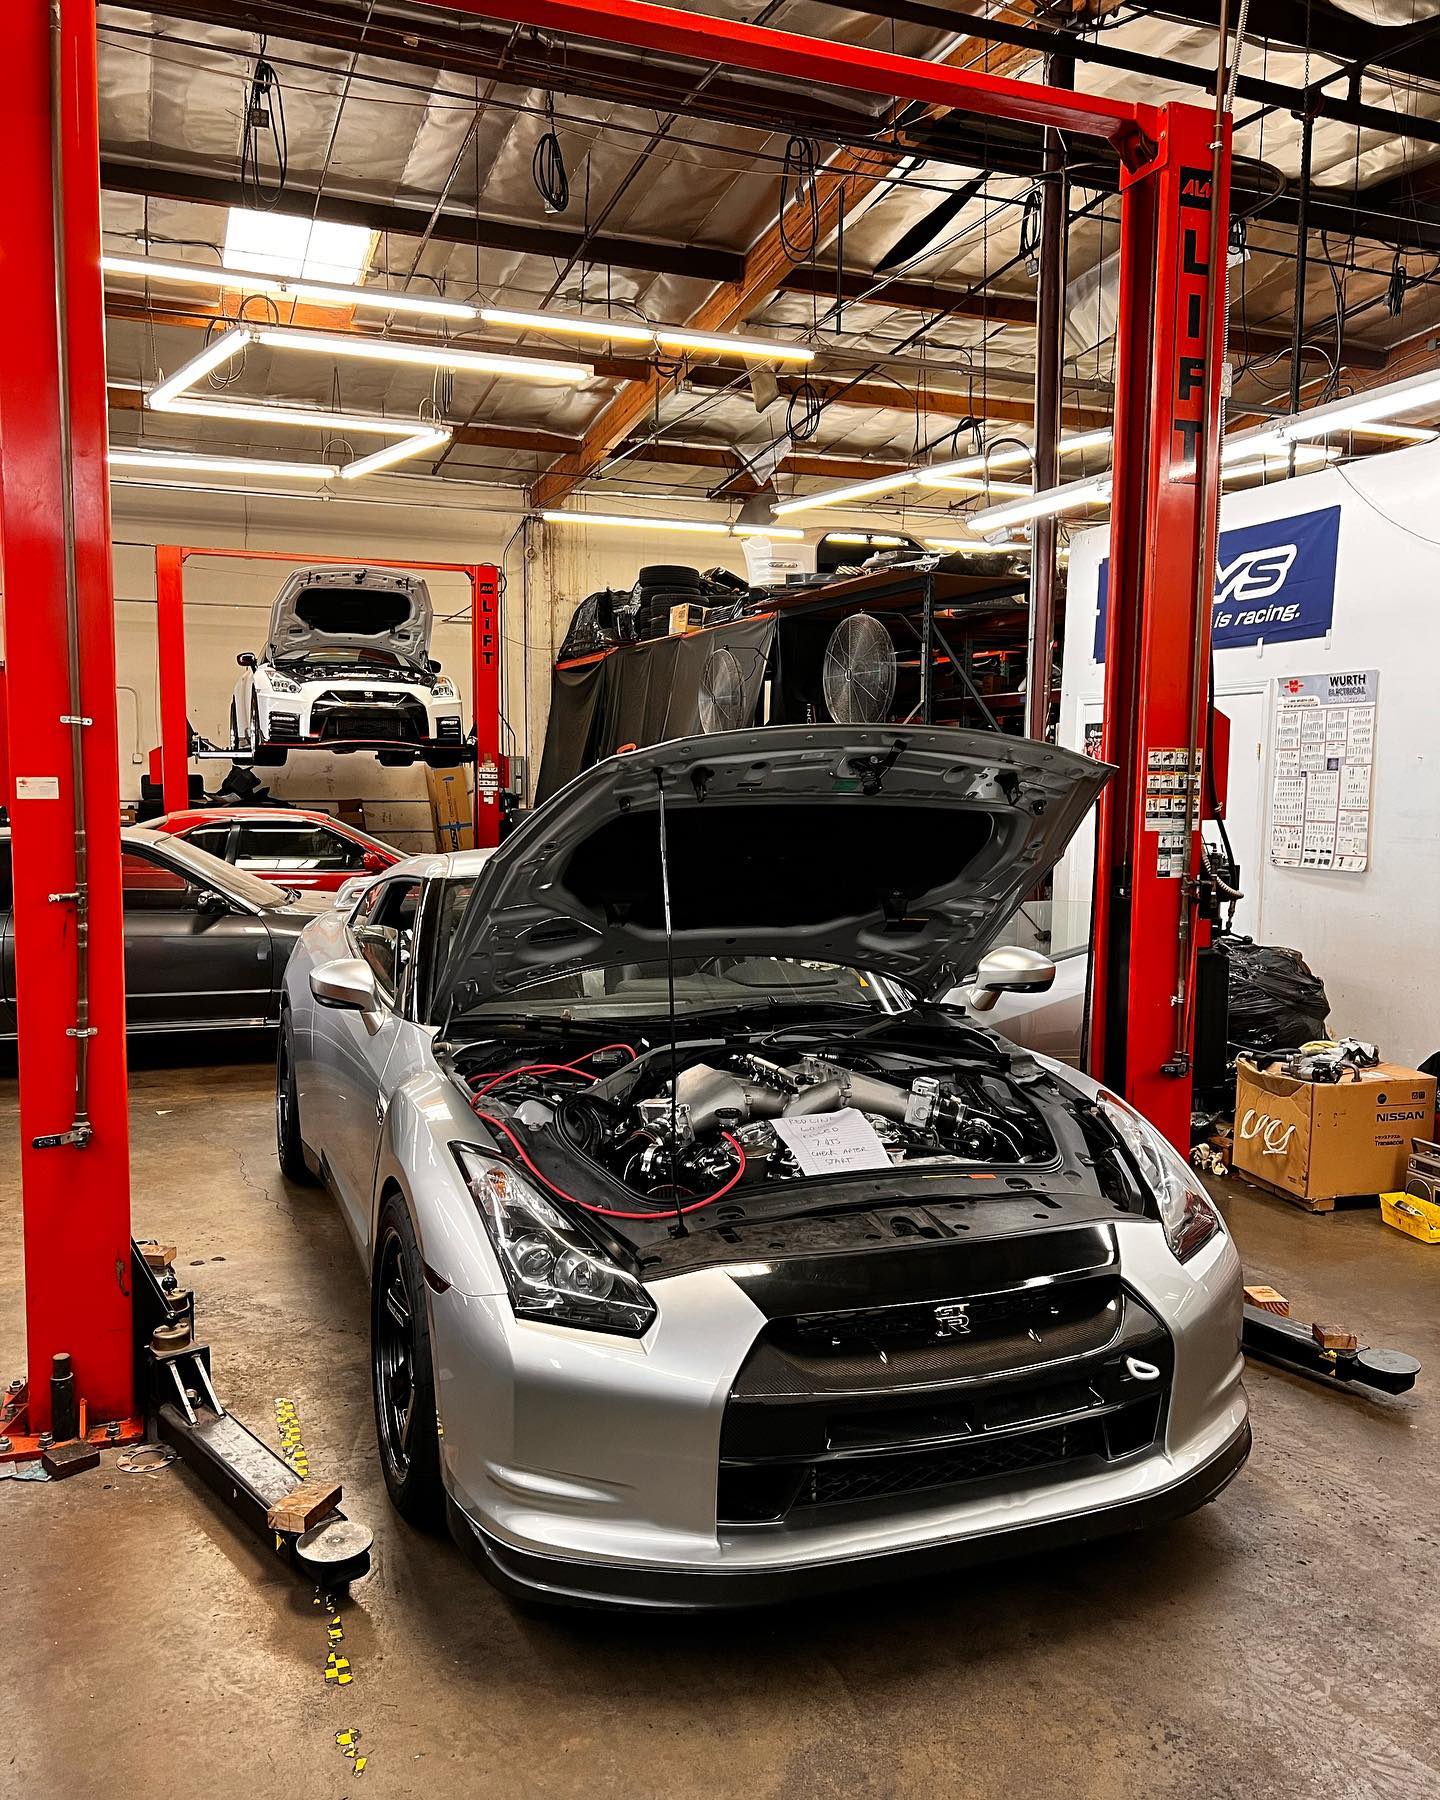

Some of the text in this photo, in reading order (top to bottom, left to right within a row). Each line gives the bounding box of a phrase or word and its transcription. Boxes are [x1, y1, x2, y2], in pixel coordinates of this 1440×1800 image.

[1175, 229, 1210, 468] LIFT
[1214, 603, 1301, 628] is racing.
[482, 599, 494, 665] LIFT
[1329, 674, 1366, 687] WURTH
[1376, 1110, 1425, 1122] NISSAN
